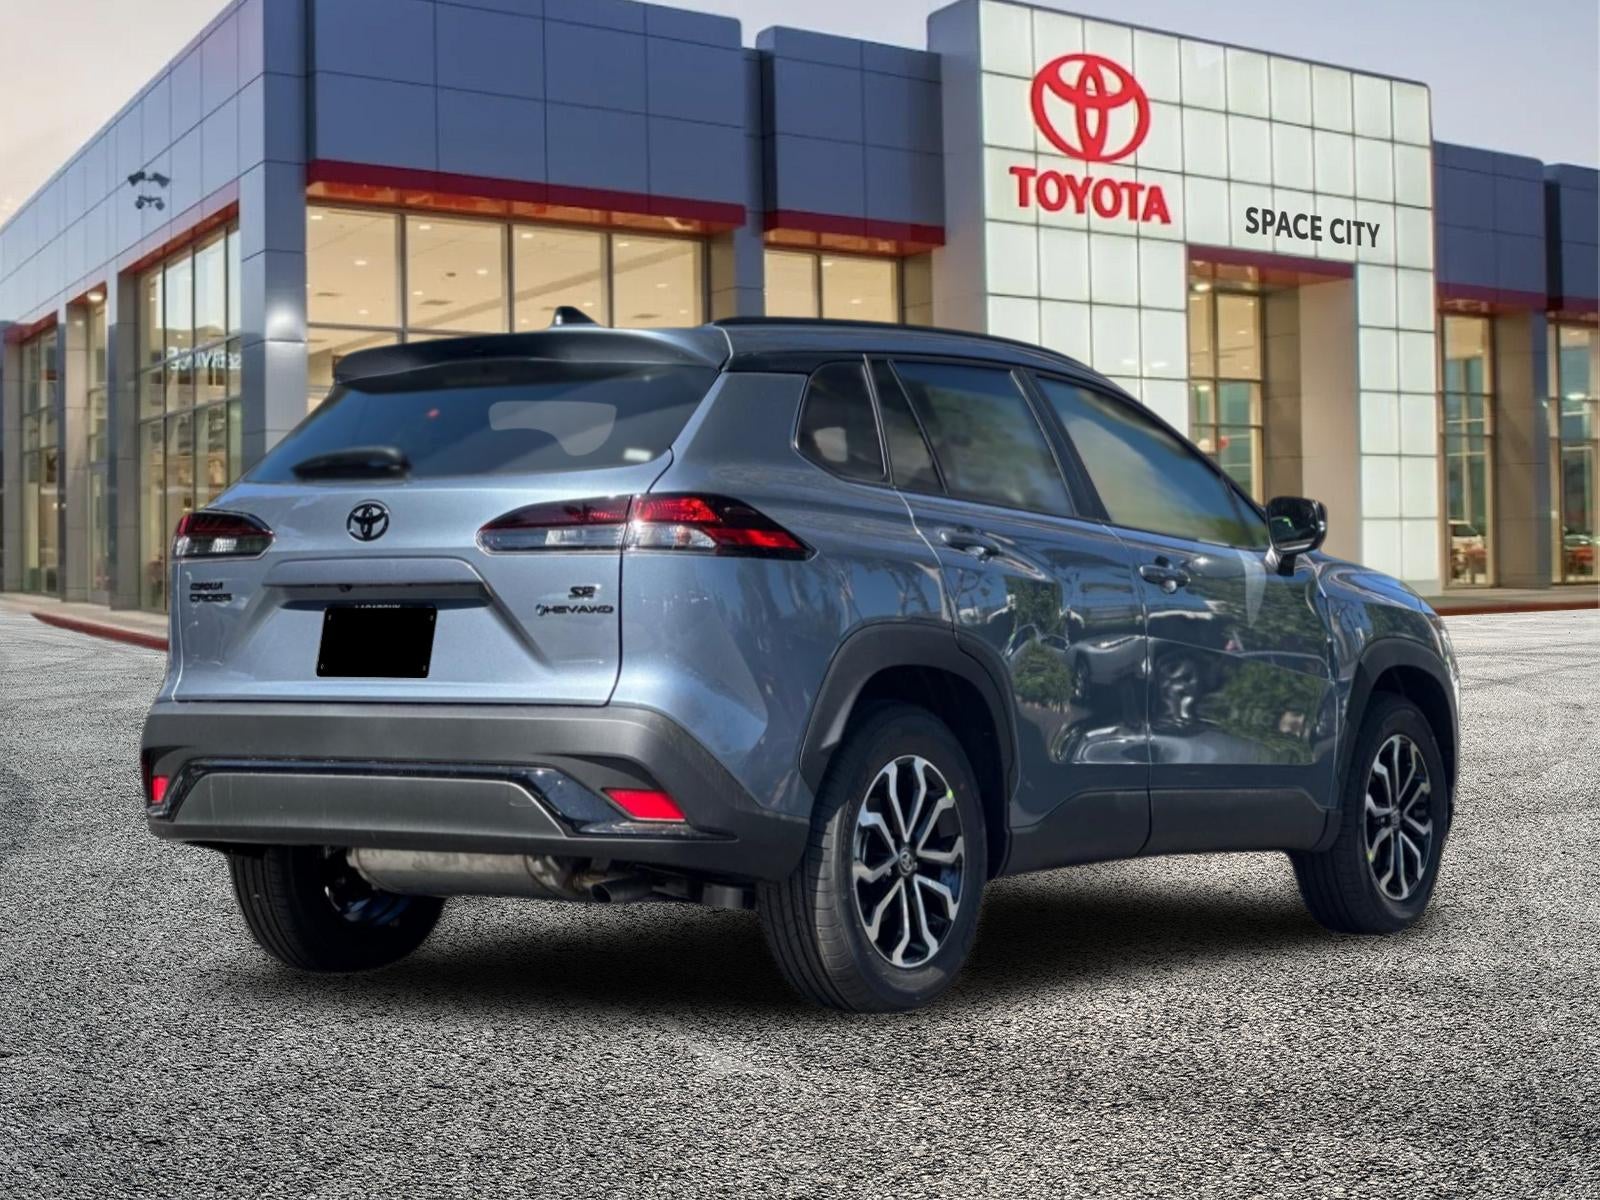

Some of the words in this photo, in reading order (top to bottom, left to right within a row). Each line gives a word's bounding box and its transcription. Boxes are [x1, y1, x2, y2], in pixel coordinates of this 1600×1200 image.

[1009, 166, 1171, 224] TOYOTA
[1245, 206, 1323, 242] SPACE
[1329, 218, 1381, 248] CITY
[190, 593, 232, 602] CROSS
